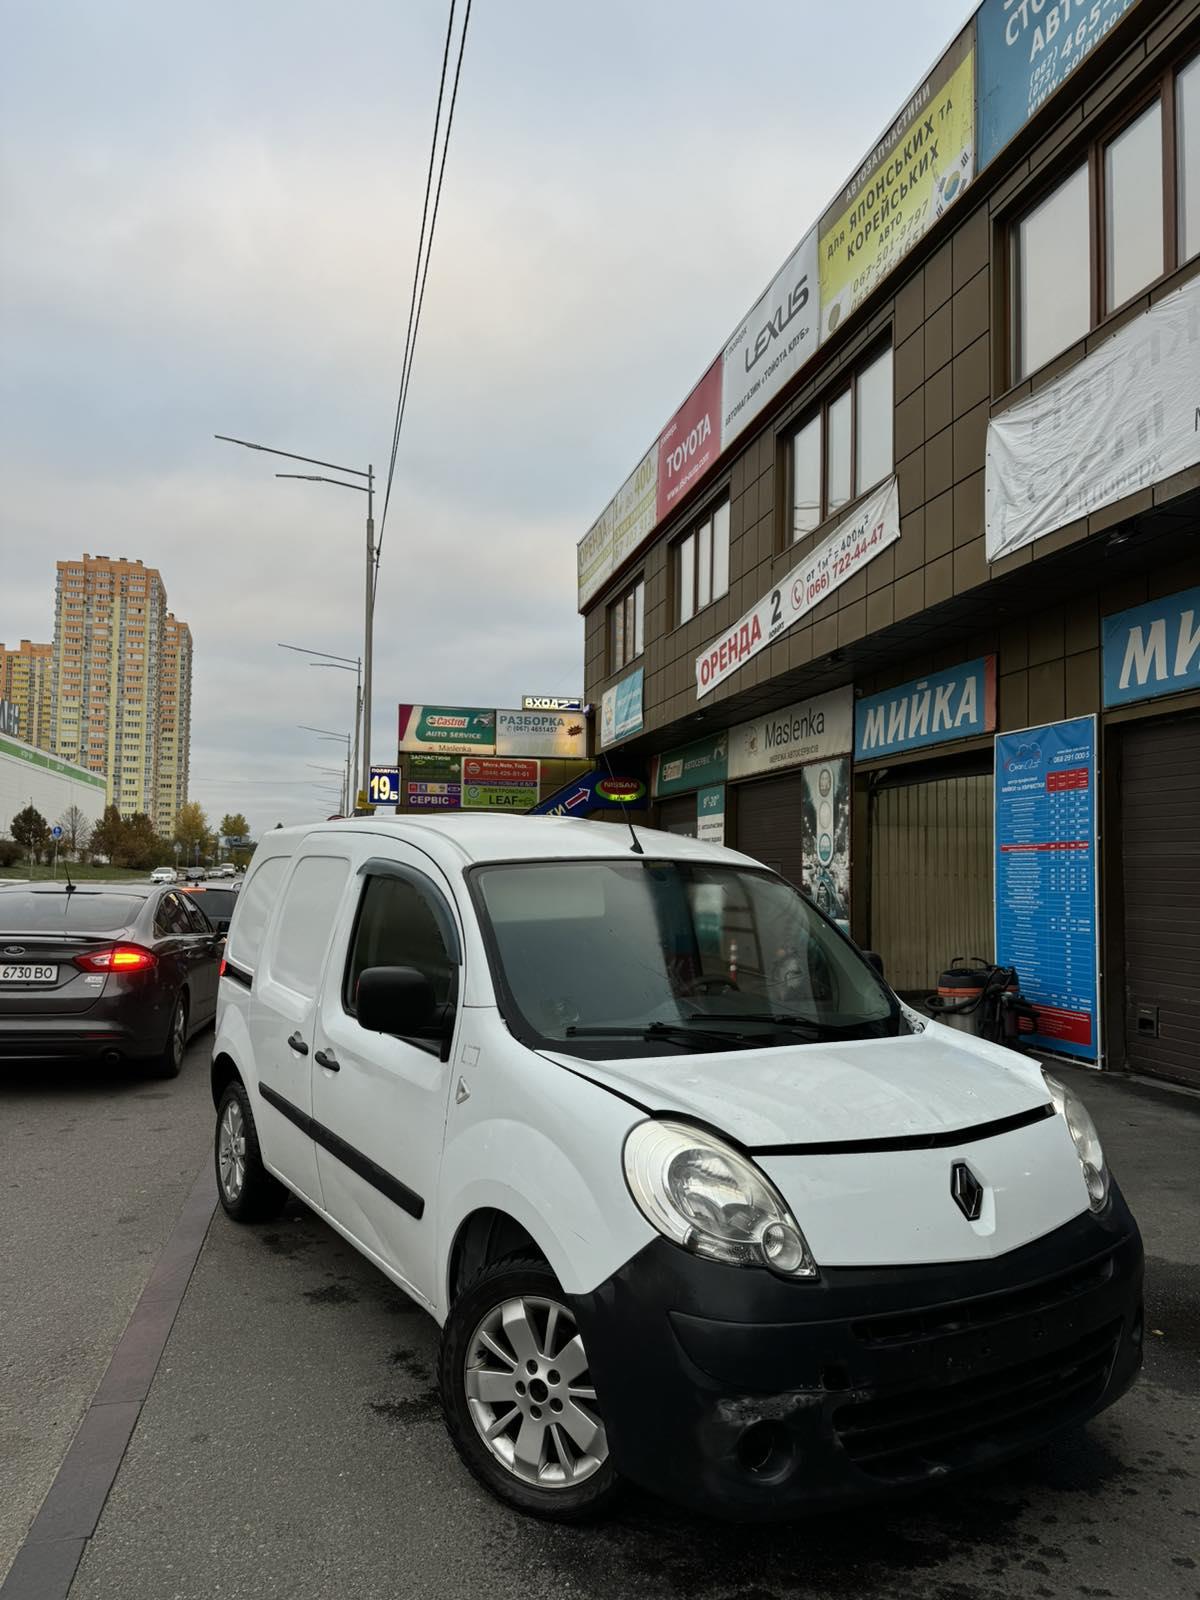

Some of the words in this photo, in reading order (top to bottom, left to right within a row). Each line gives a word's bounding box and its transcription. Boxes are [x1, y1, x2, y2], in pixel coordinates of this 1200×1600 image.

[846, 83, 930, 202] АВТОЗАПЧАСТИНИ
[850, 114, 934, 233] ЯПОНСЬКИХ
[847, 139, 939, 262] КОРЕЙСЬКИХ
[878, 211, 903, 247] АВТО
[745, 274, 809, 373] LEXUS
[666, 413, 711, 478] TOYOTA
[807, 571, 830, 604] (066)
[833, 523, 884, 579] 722-44-47
[701, 613, 762, 686] ОРЕНДА
[771, 589, 781, 625] 2
[436, 717, 466, 727] Castrol
[500, 716, 565, 726] РАЗБОРКА
[525, 697, 559, 709] ВХОД
[862, 676, 978, 751] МИЙКА
[438, 744, 472, 752] Maslenka
[449, 731, 481, 739] SERVICE
[764, 707, 825, 750] Maslenka
[409, 795, 449, 804] СЕРВІС
[489, 795, 518, 805] LEAF
[3, 967, 31, 978] 6730
[34, 967, 52, 979] BO
